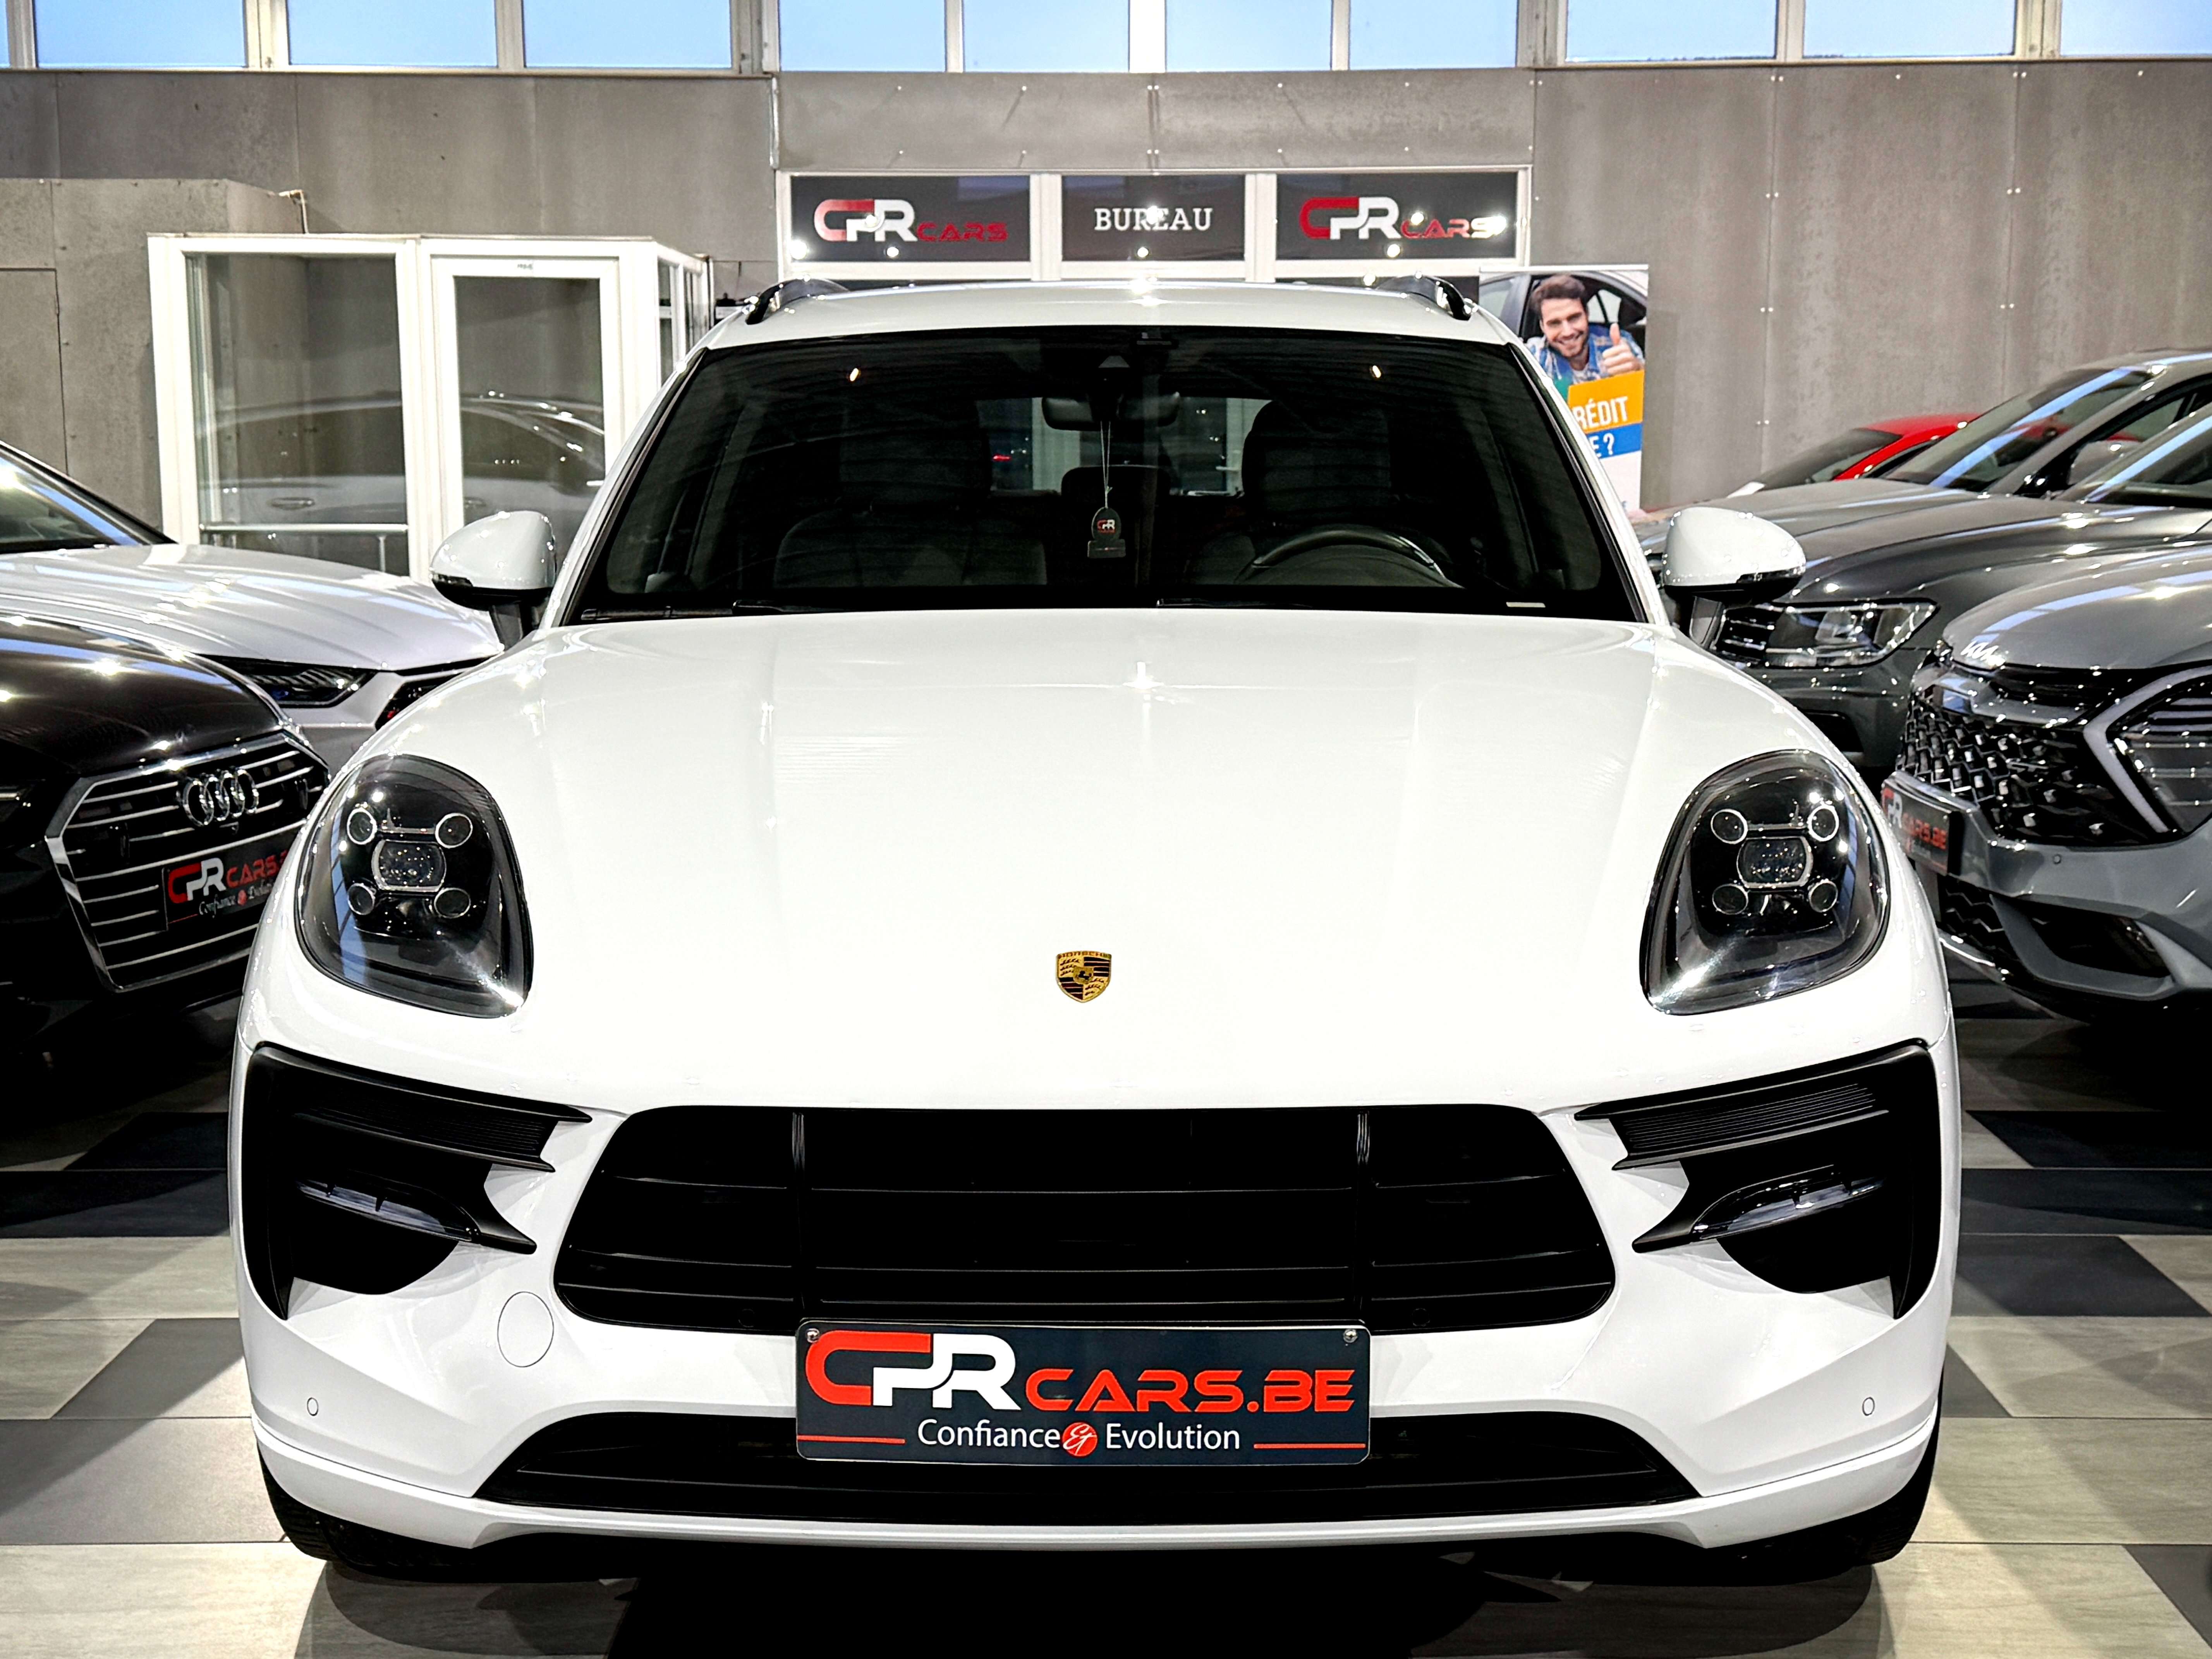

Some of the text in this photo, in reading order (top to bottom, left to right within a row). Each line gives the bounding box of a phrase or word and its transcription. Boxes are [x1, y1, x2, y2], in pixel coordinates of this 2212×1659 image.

[814, 198, 1009, 242] CPR CARS
[1094, 207, 1213, 231] BUREAU
[1298, 197, 1499, 240] CPR CARS
[1572, 396, 1628, 430] RÉDIT
[168, 857, 227, 903] CPR
[227, 850, 287, 888] CARS
[805, 1329, 1355, 1413] CPR CARS.BE
[917, 1418, 1061, 1448] Confiance
[1106, 1422, 1240, 1450] Evolution
